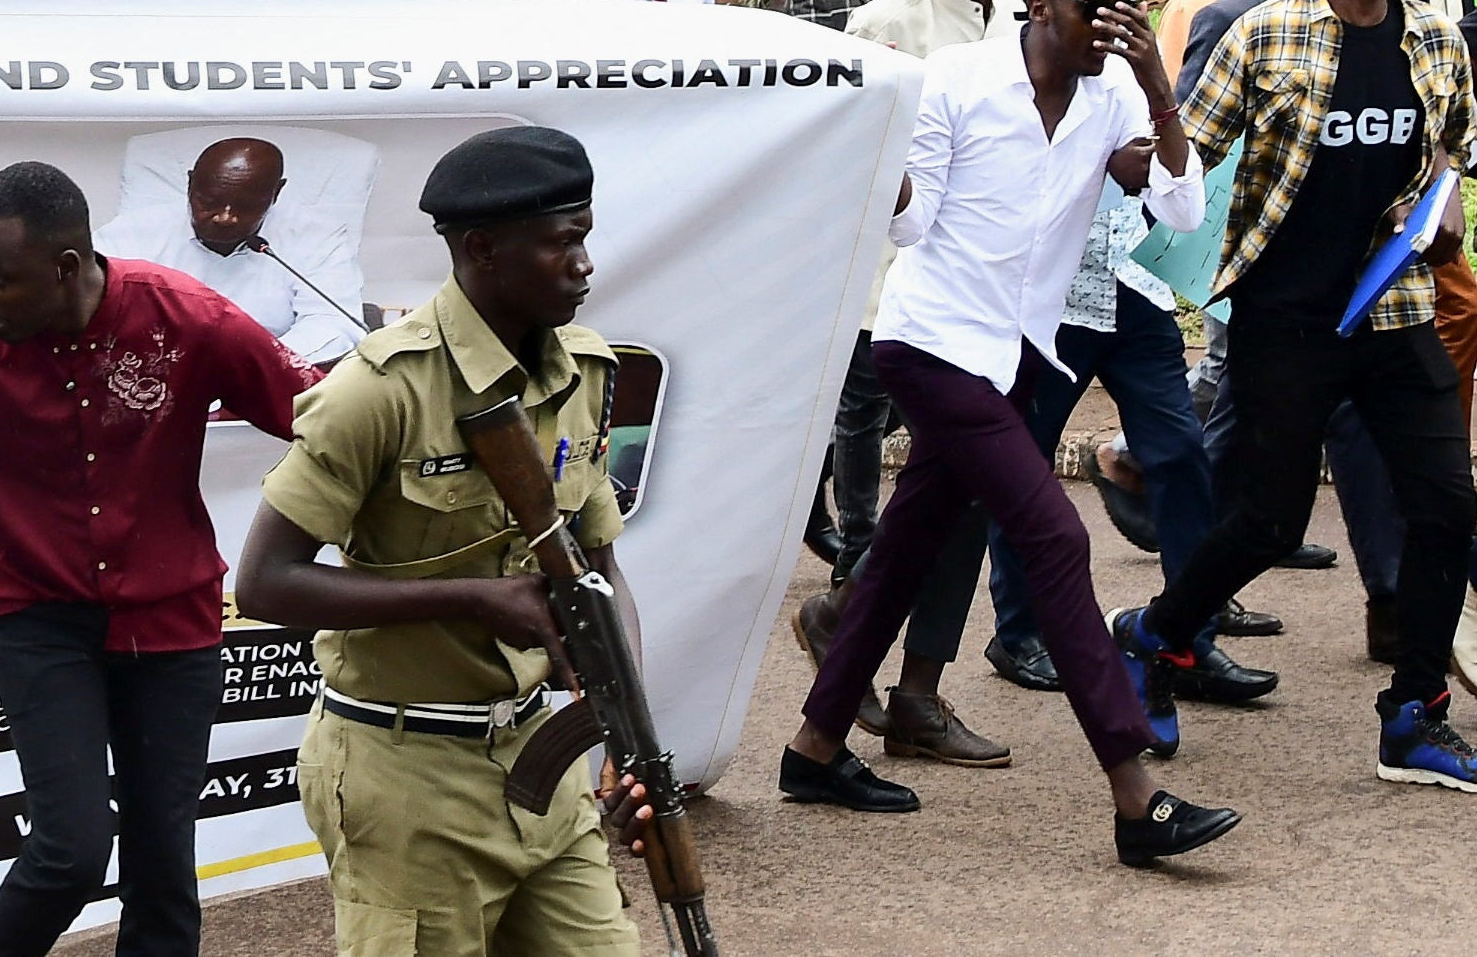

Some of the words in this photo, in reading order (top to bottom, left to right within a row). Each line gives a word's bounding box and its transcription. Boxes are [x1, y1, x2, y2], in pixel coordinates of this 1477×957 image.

[90, 60, 412, 91] STUDENTS'
[431, 57, 864, 89] APPRECIATION
[222, 683, 282, 704] BILL
